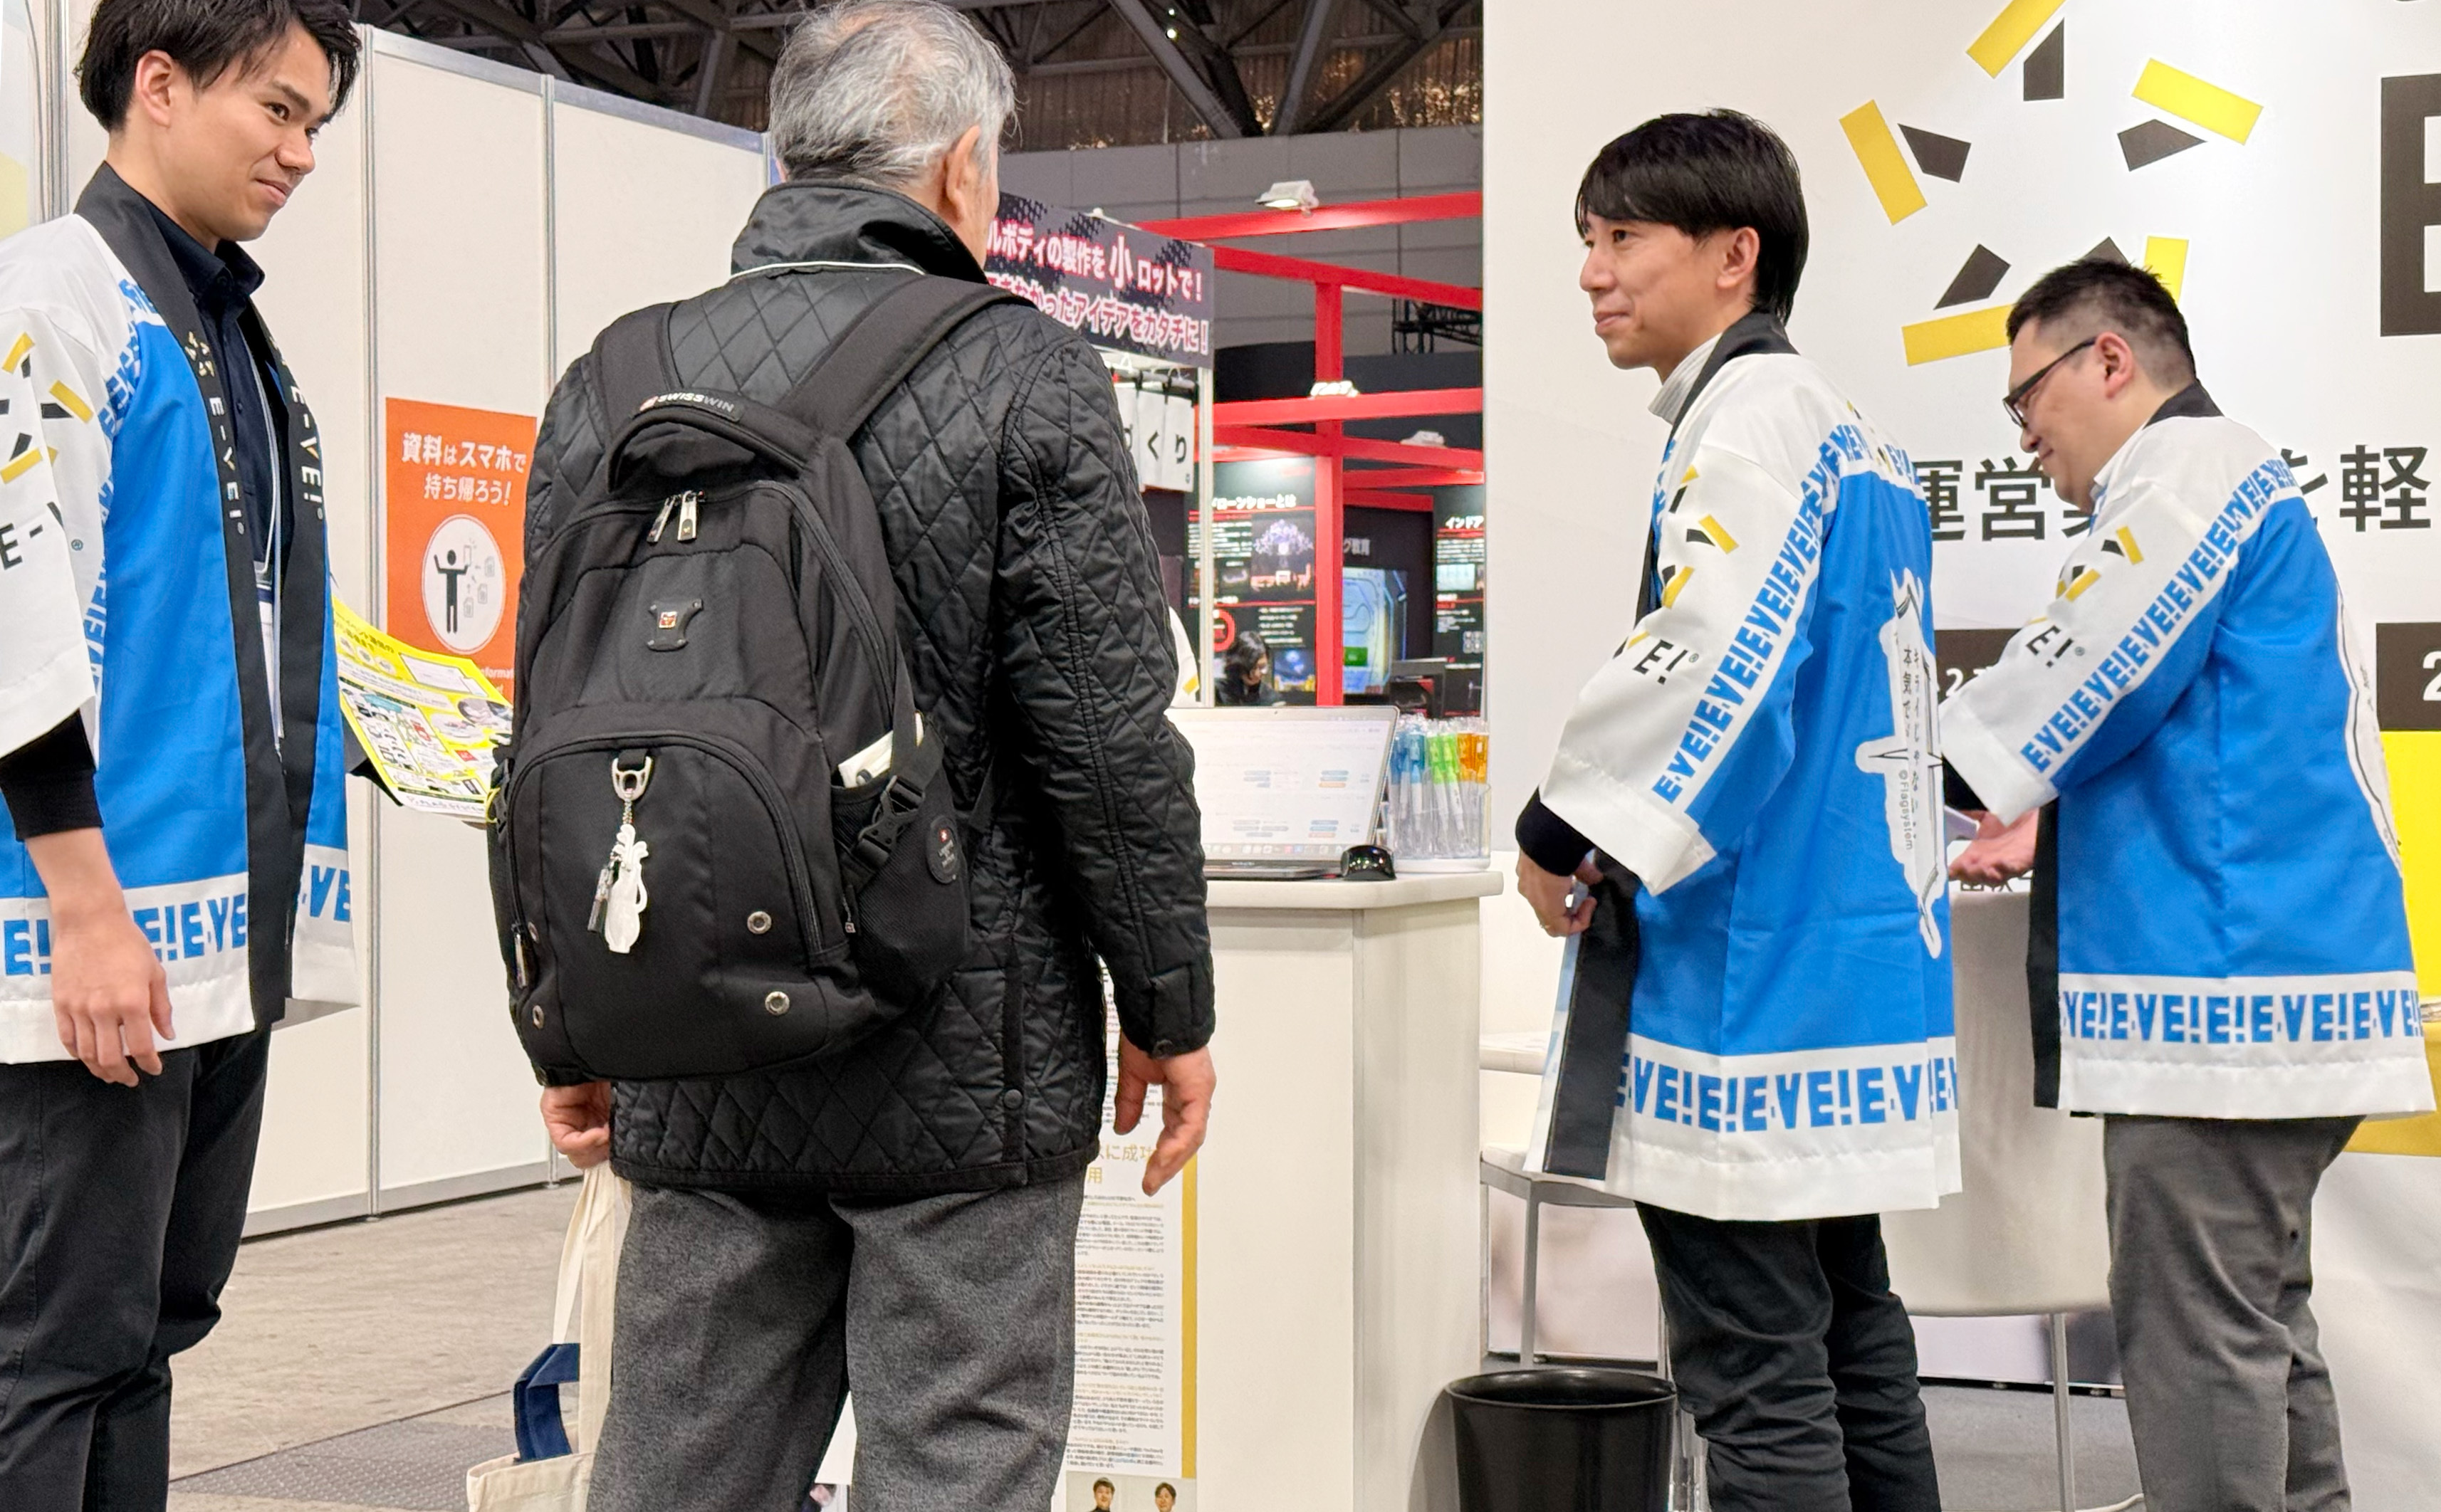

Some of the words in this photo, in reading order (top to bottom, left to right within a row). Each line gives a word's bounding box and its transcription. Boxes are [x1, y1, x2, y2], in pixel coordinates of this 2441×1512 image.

[402, 432, 526, 473] 資料はスマホで
[424, 472, 511, 505] 持ち帰ろう！
